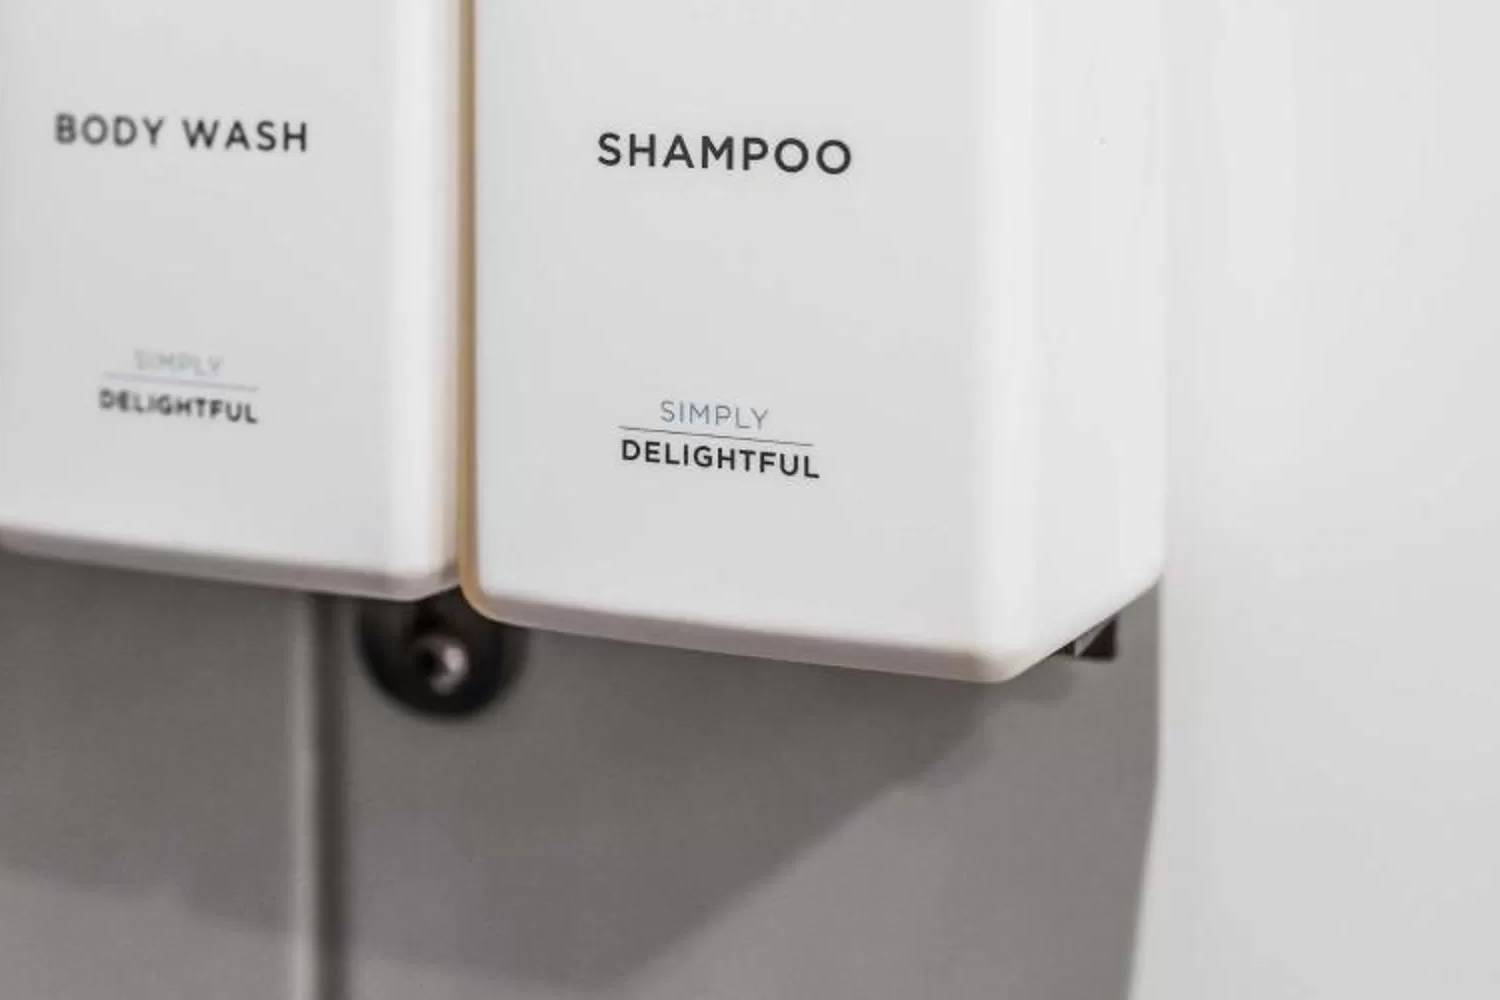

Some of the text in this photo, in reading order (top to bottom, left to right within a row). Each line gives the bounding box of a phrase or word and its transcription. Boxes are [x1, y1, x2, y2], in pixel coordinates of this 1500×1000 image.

[54, 112, 307, 152] BODY WASH
[597, 131, 851, 175] SHAMPOO
[98, 388, 258, 424] DELIGHTFUL
[659, 400, 769, 430] SIMPLY
[620, 439, 820, 479] DELIGHTFUL
